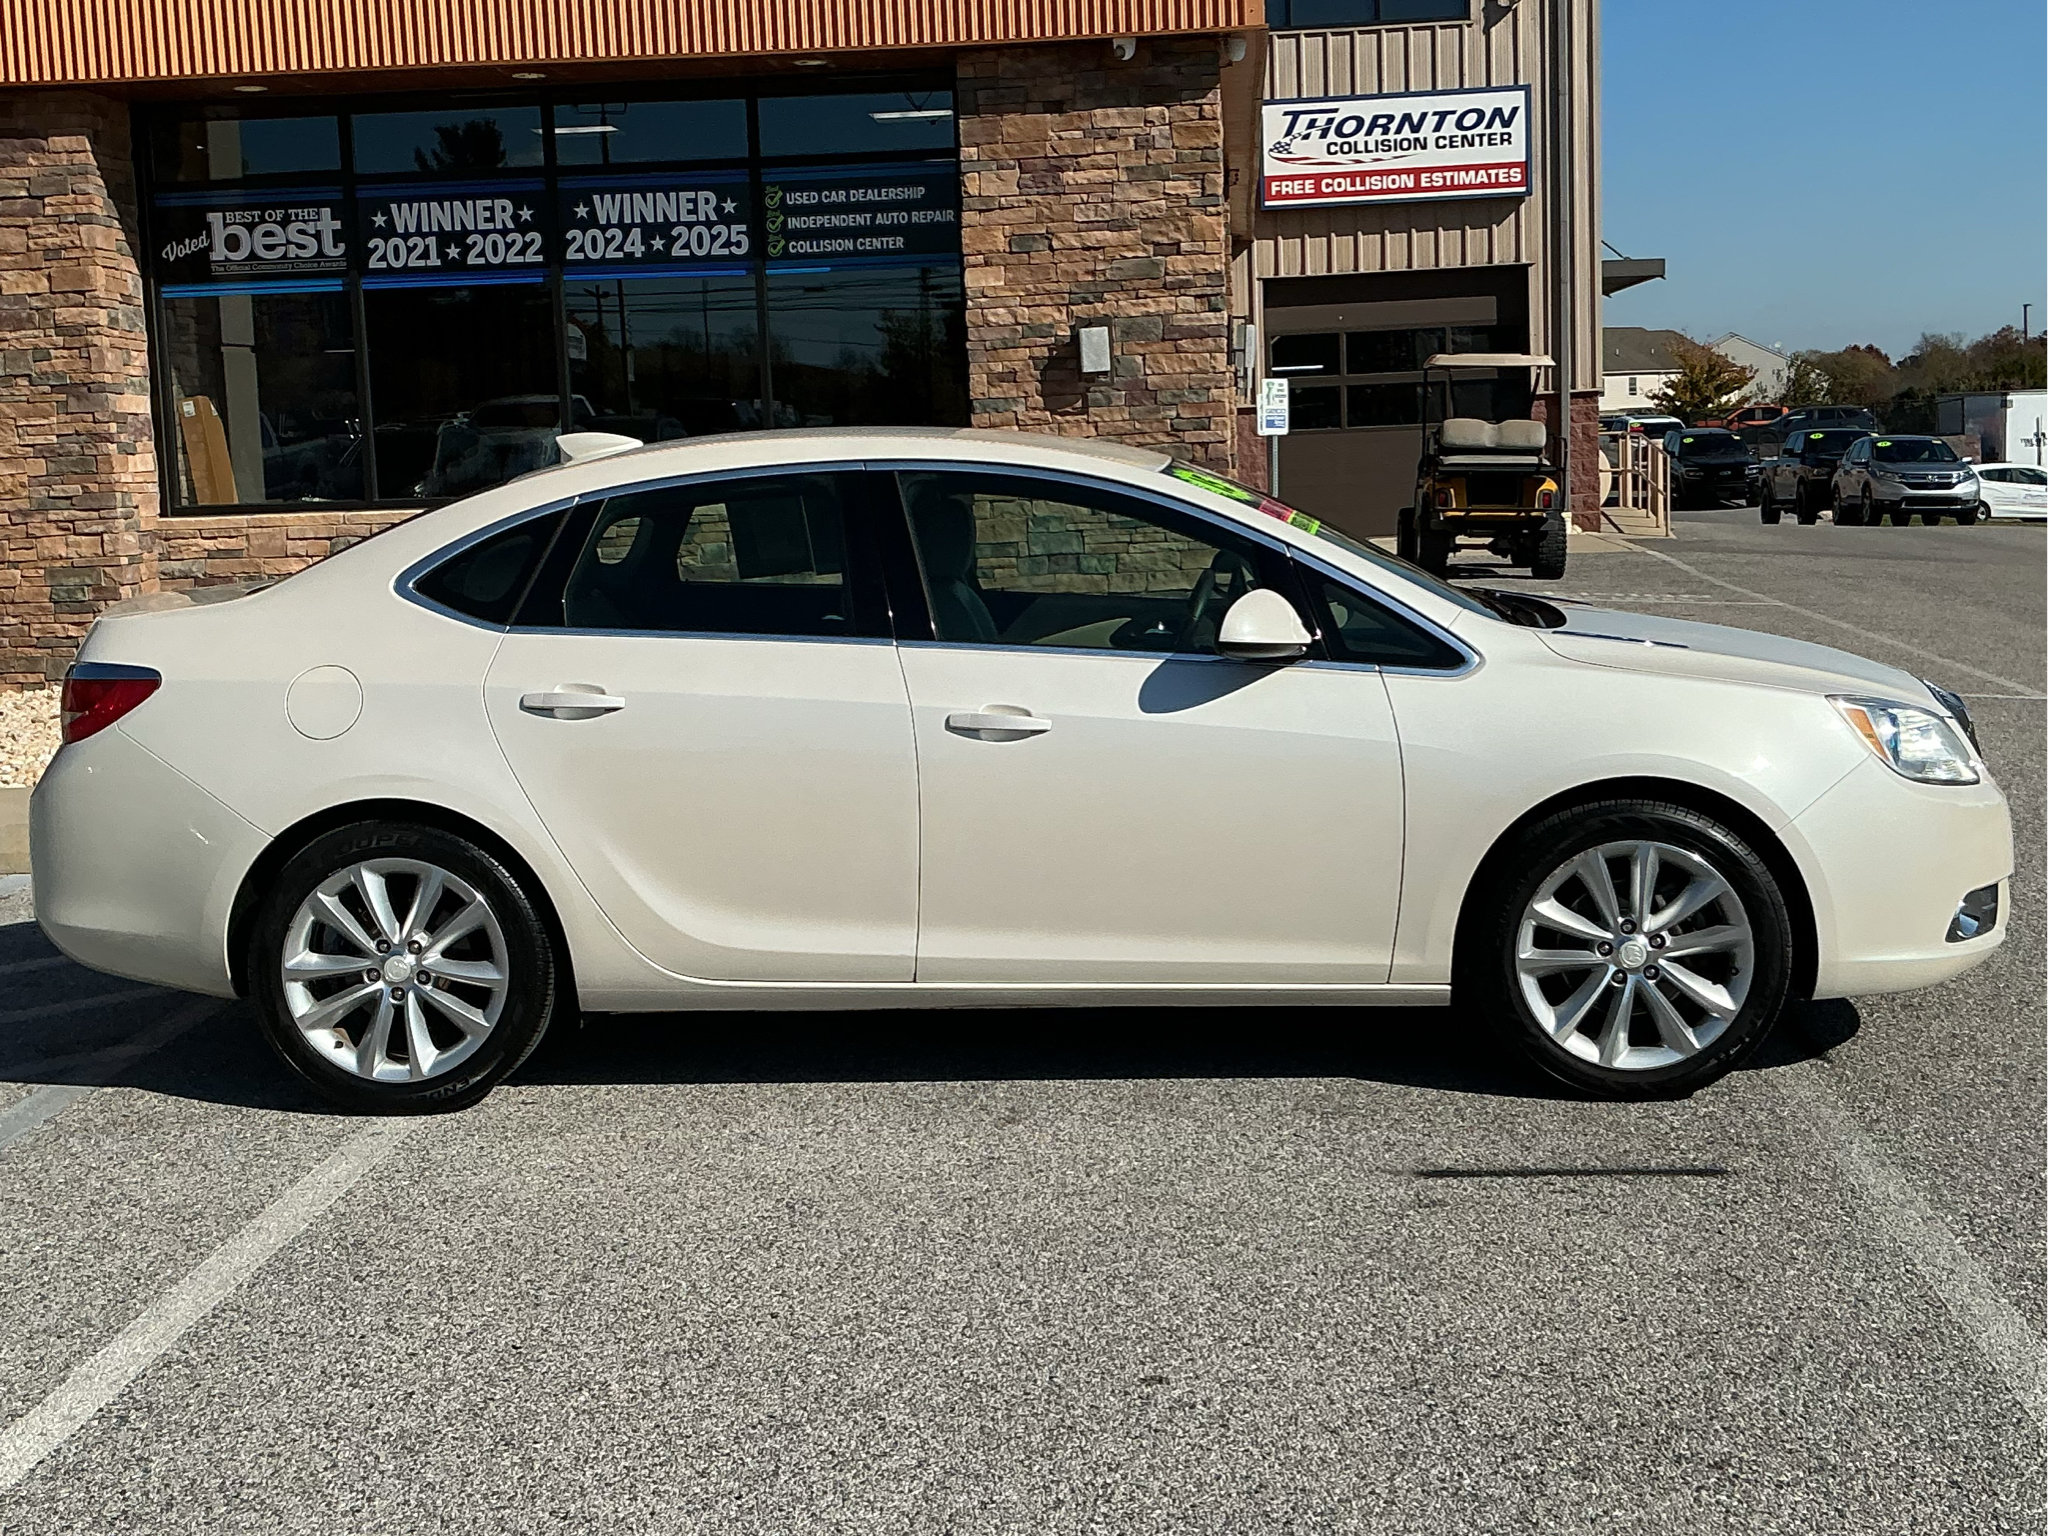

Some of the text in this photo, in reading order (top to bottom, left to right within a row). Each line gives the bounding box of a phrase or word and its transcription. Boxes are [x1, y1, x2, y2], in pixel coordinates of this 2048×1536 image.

[1282, 106, 1520, 140] THORNTON
[1326, 132, 1512, 156] COLLISION CENTER
[786, 186, 926, 205] USED CAR DEALERSHIP
[1271, 168, 1522, 195] FREE COLLISION ESTIMATES
[225, 208, 318, 224] BEST OF THE
[390, 199, 515, 232] WINNER
[592, 191, 718, 224] WINNER
[787, 213, 872, 229] INDEPENDENT
[875, 212, 908, 225] AUTO
[912, 210, 955, 223] REPAIR
[161, 230, 212, 262] Voted
[206, 208, 346, 261] best
[367, 232, 543, 268] 2021 2022
[565, 225, 749, 260] 2024 2025
[788, 238, 853, 254] COLLISION
[856, 237, 904, 251] CENTER
